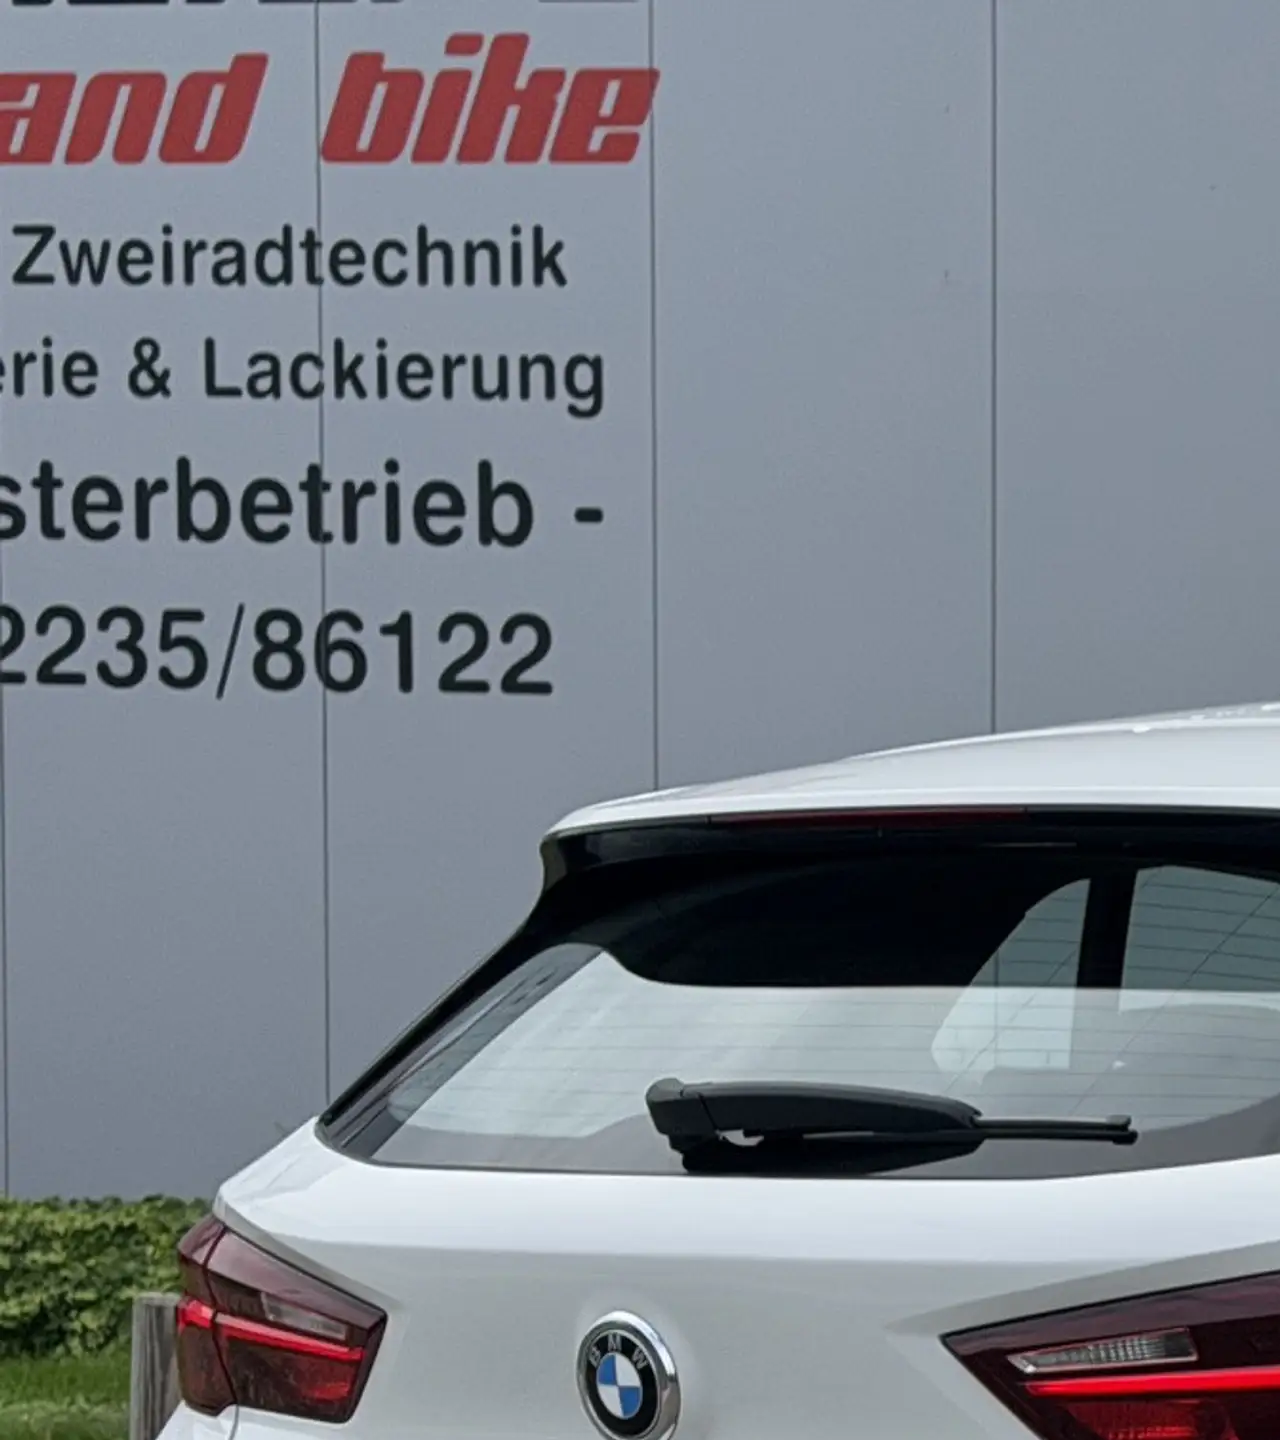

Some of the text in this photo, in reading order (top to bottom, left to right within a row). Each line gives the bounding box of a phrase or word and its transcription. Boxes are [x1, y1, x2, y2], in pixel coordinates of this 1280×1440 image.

[0, 33, 659, 165] and bike
[12, 225, 567, 286] Zweiradtechnik
[0, 338, 603, 418] rie & Lackierung
[589, 1333, 647, 1369] BMW
